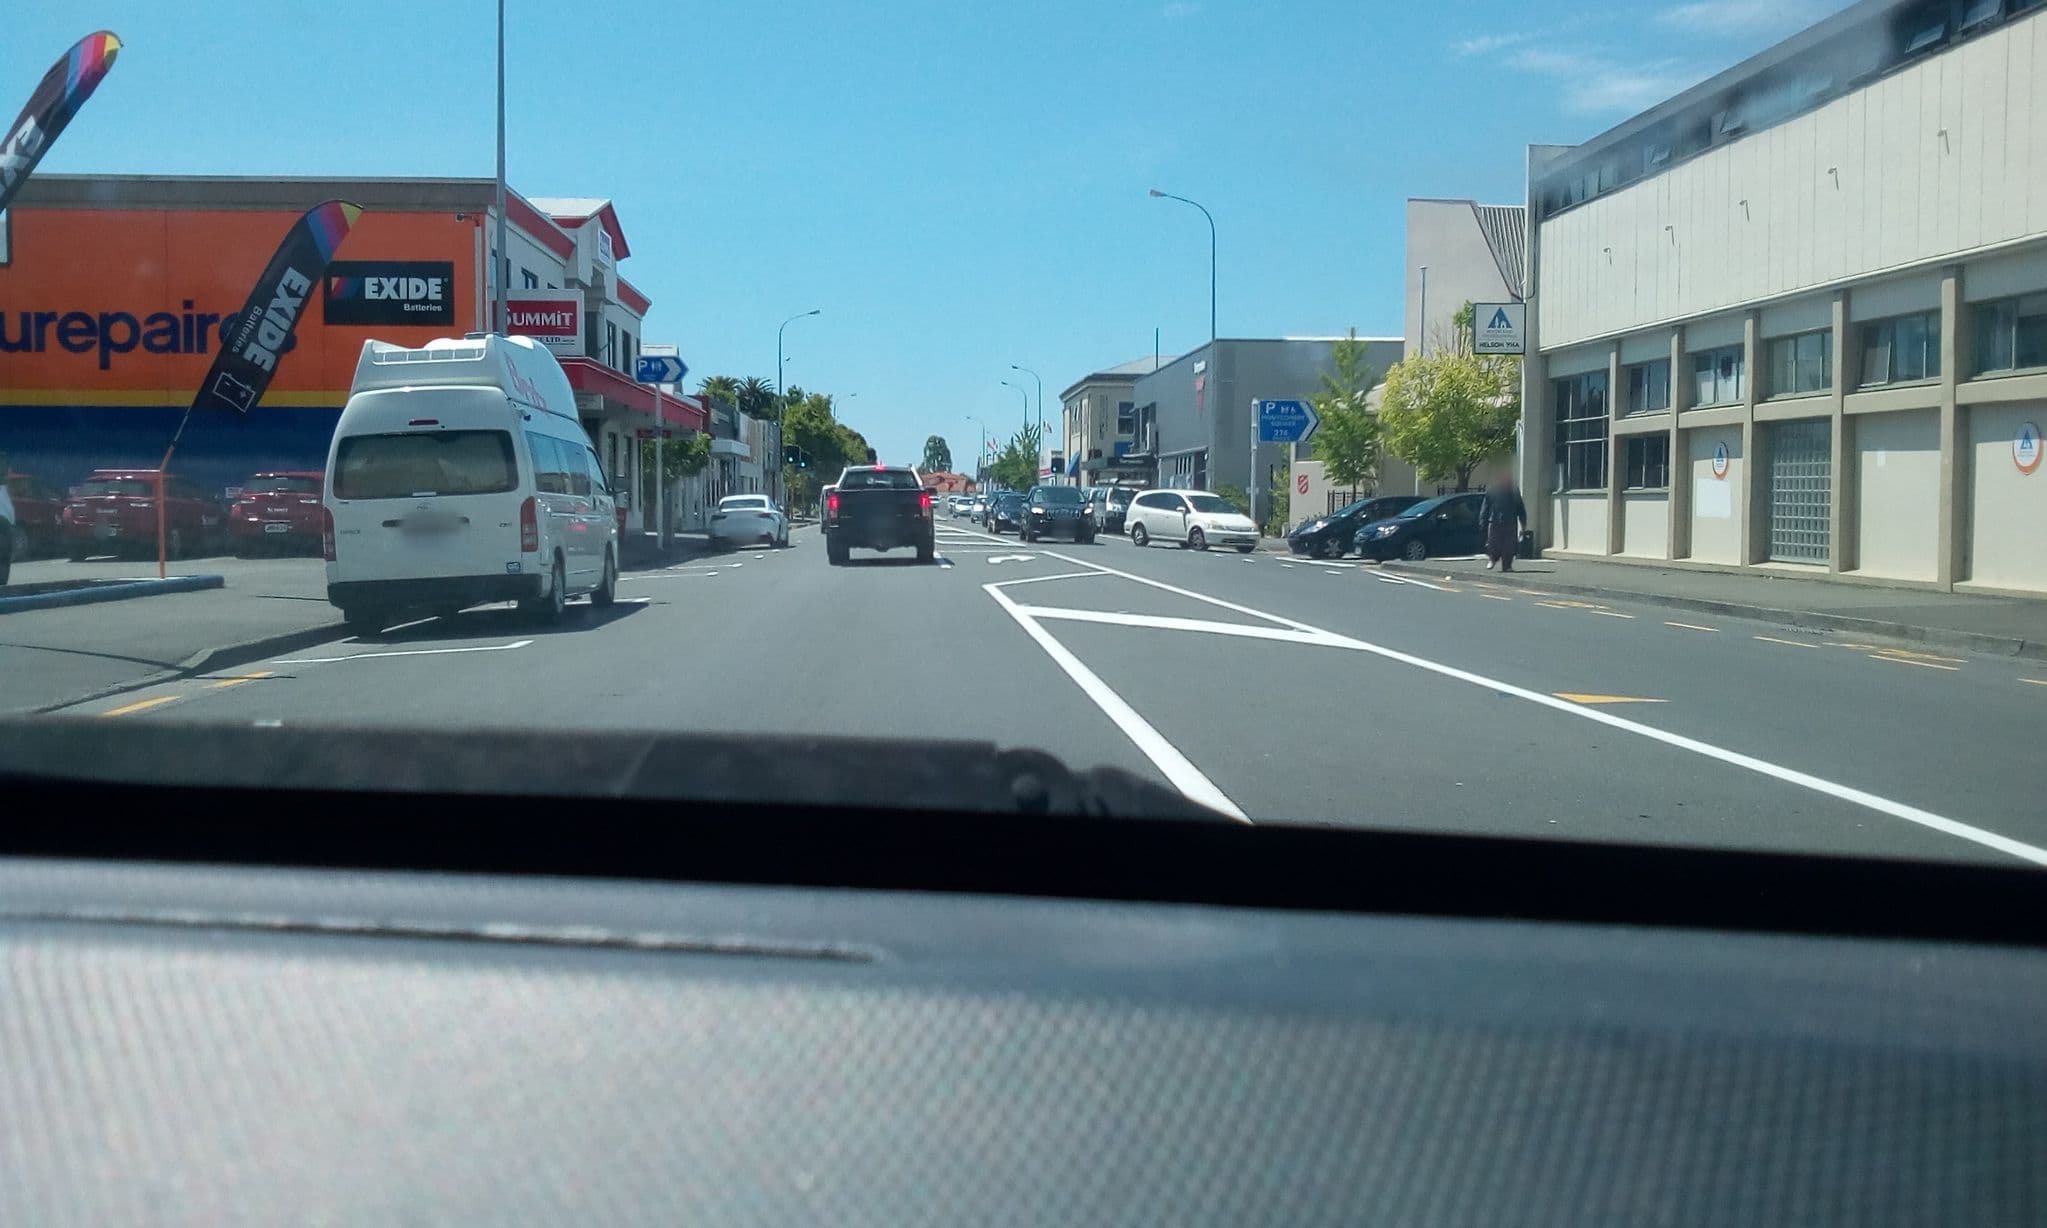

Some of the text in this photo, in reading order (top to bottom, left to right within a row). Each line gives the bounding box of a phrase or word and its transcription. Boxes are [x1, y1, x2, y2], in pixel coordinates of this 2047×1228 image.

[364, 277, 442, 300] EXIDE
[403, 303, 443, 312] Batteries
[243, 266, 312, 372] EXIDE
[231, 305, 263, 353] Batteries
[638, 360, 648, 373] P
[1265, 402, 1276, 414] P
